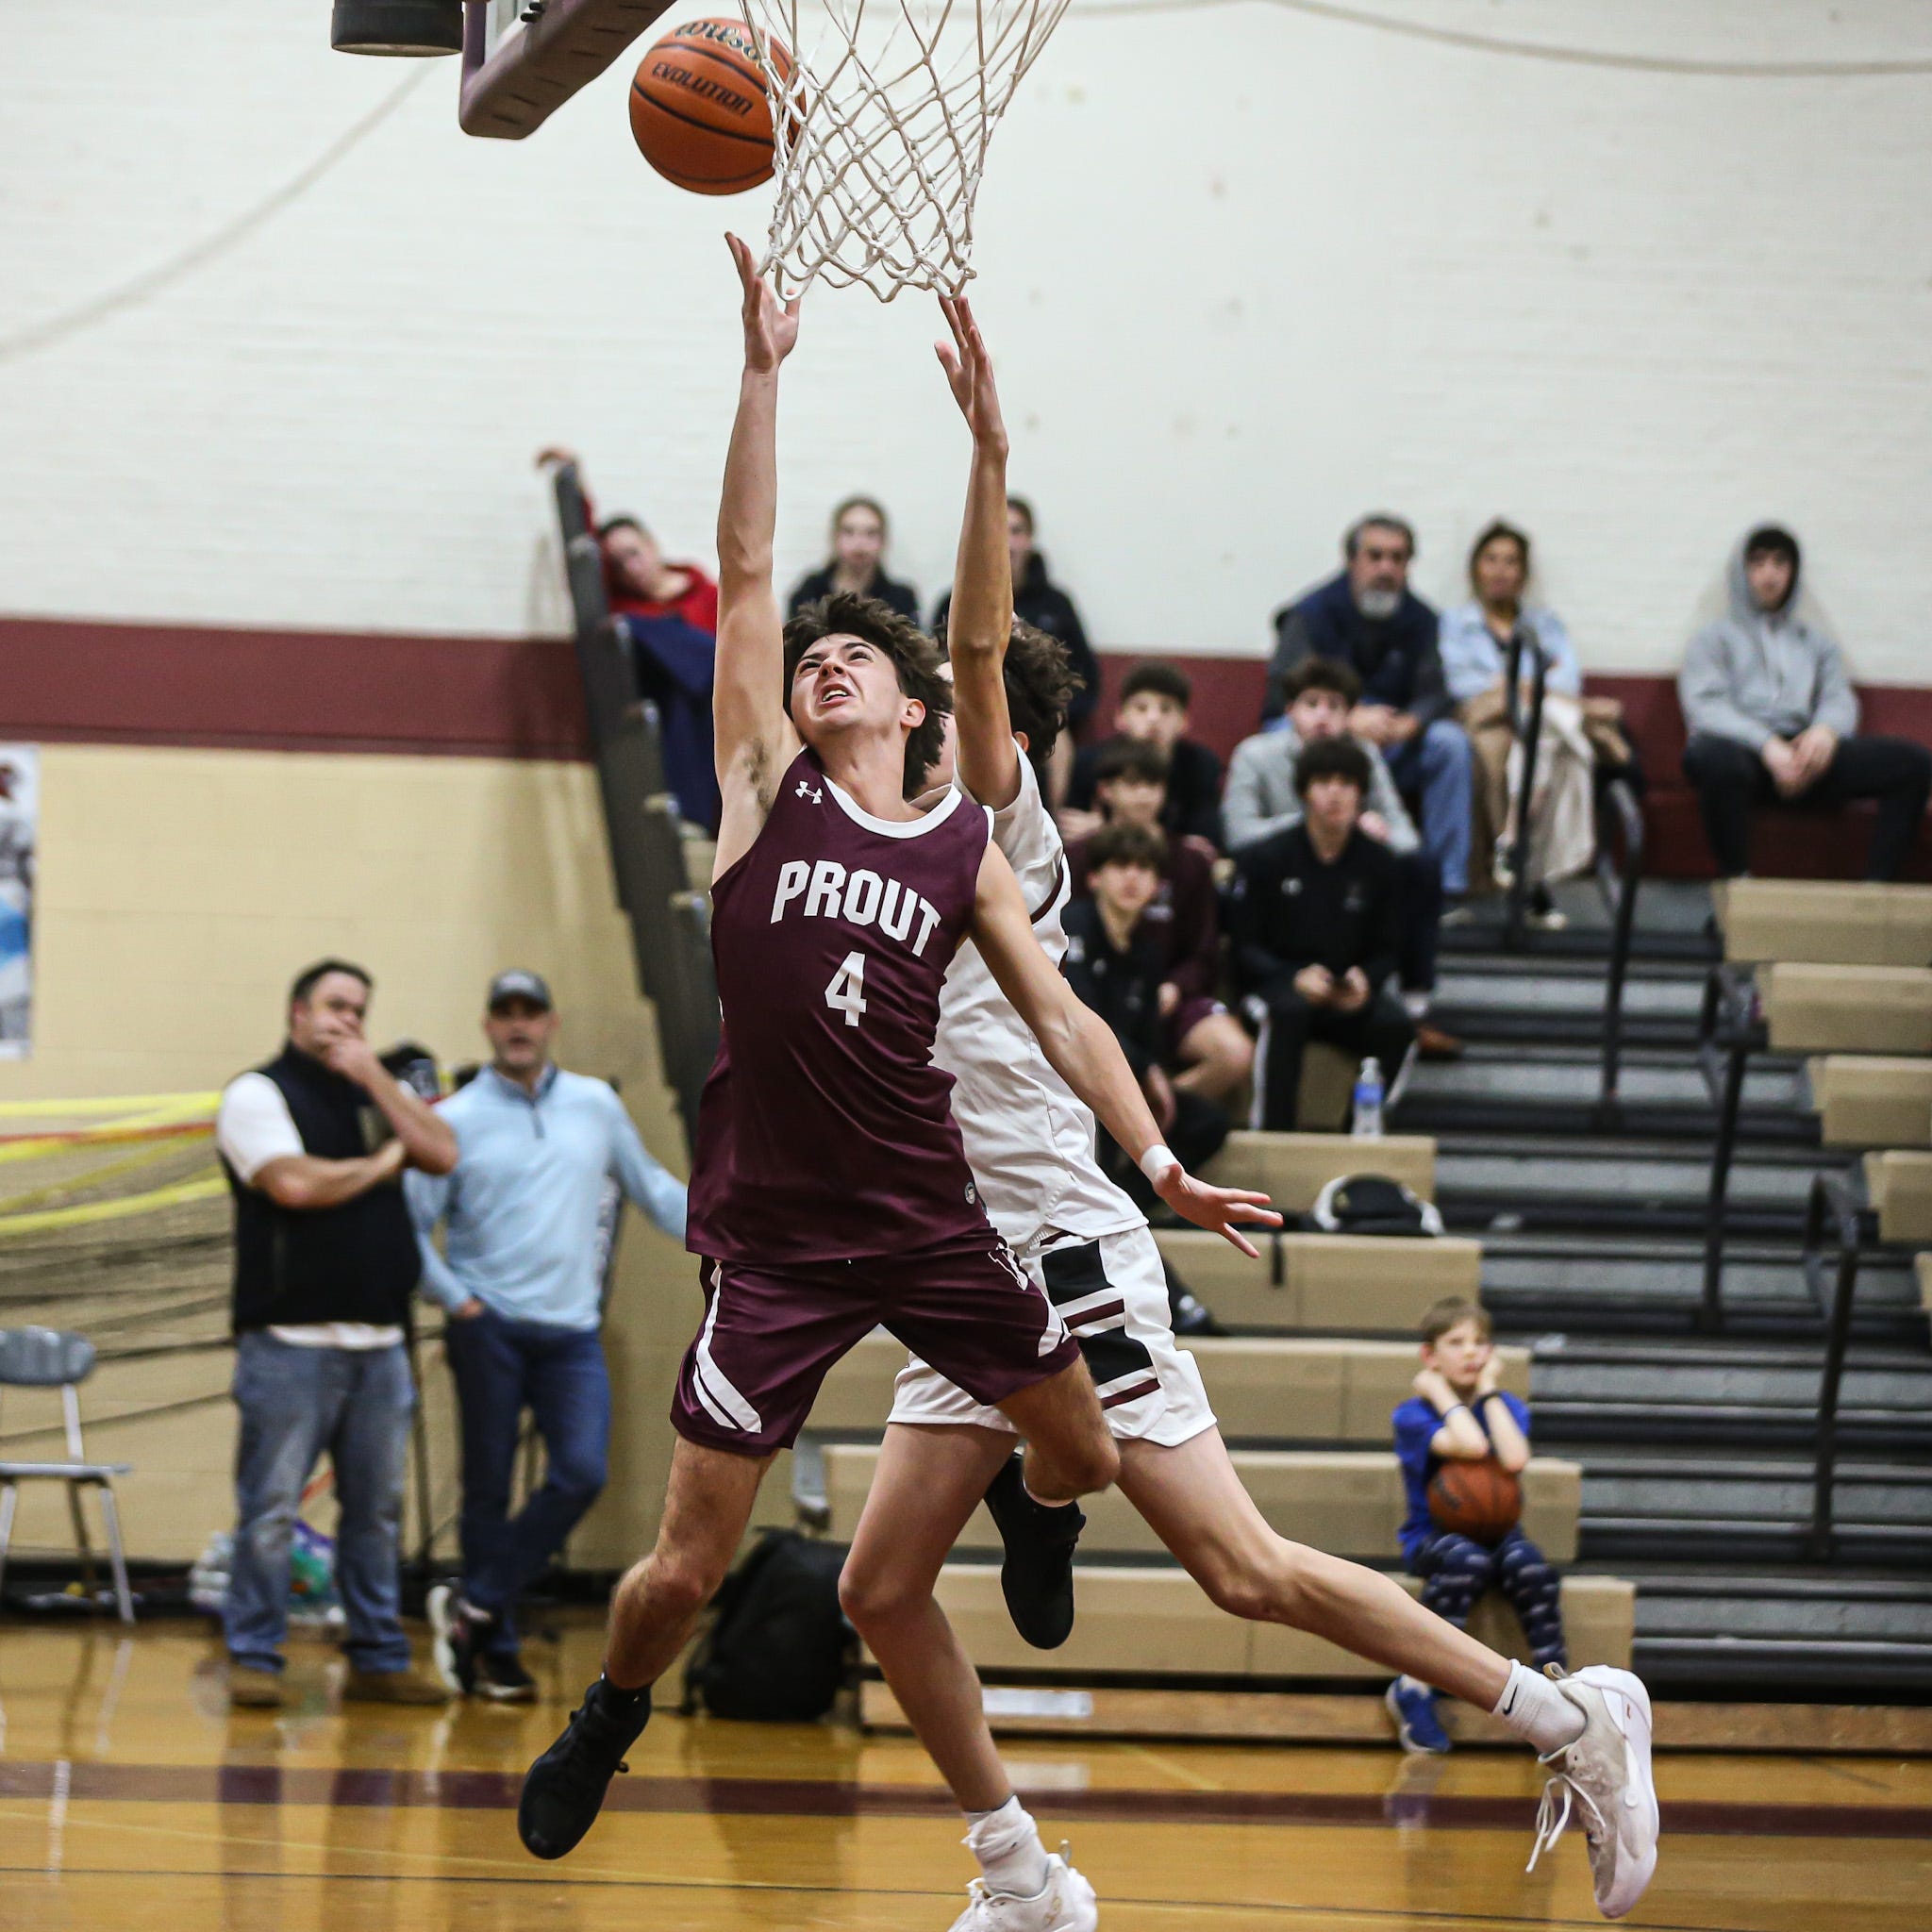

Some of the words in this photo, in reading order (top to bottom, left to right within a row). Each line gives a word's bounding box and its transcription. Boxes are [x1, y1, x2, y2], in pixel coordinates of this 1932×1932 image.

[674, 22, 761, 69] Wilso
[652, 61, 753, 116] EVOLUTION
[771, 859, 941, 958] PROUT
[824, 951, 867, 1027] 4
